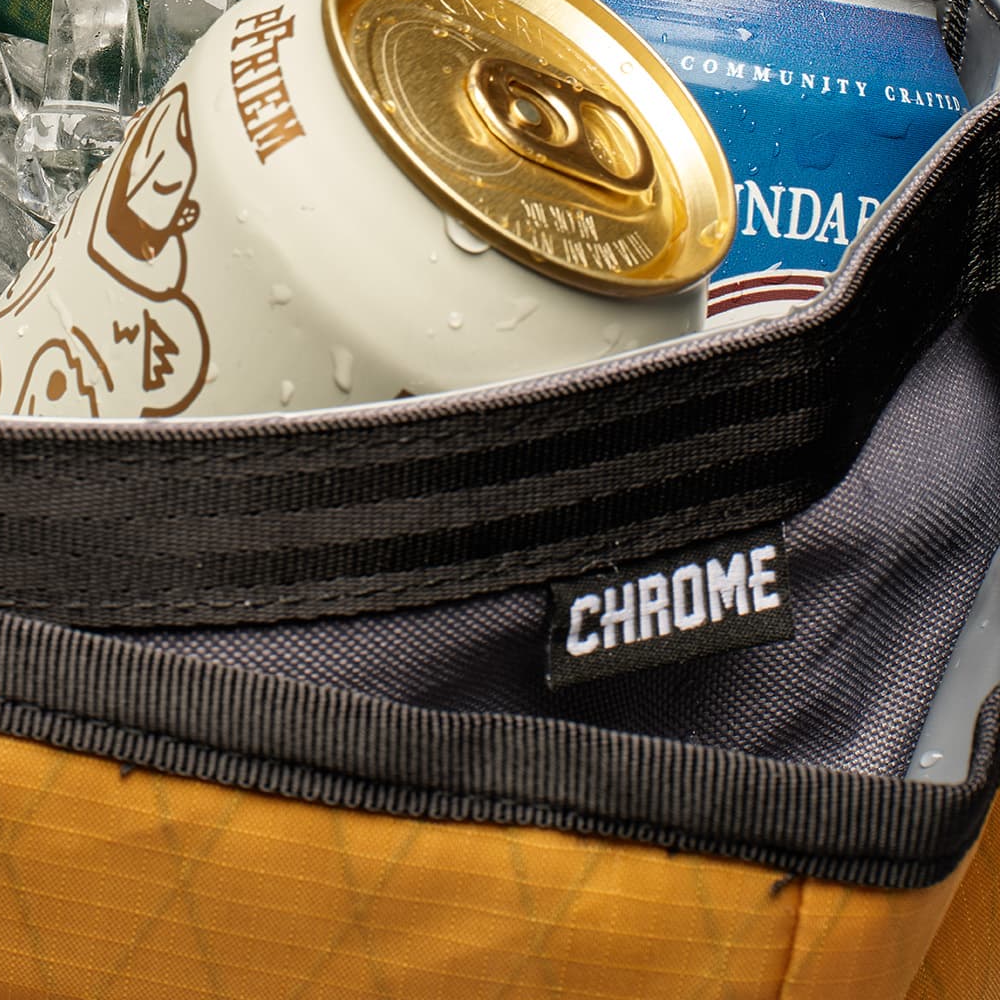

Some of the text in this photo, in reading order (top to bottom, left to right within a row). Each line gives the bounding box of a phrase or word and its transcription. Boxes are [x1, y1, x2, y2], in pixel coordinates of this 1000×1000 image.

[680, 55, 962, 112] COMMUNITY CRAFTED
[565, 545, 781, 657] CHROME
